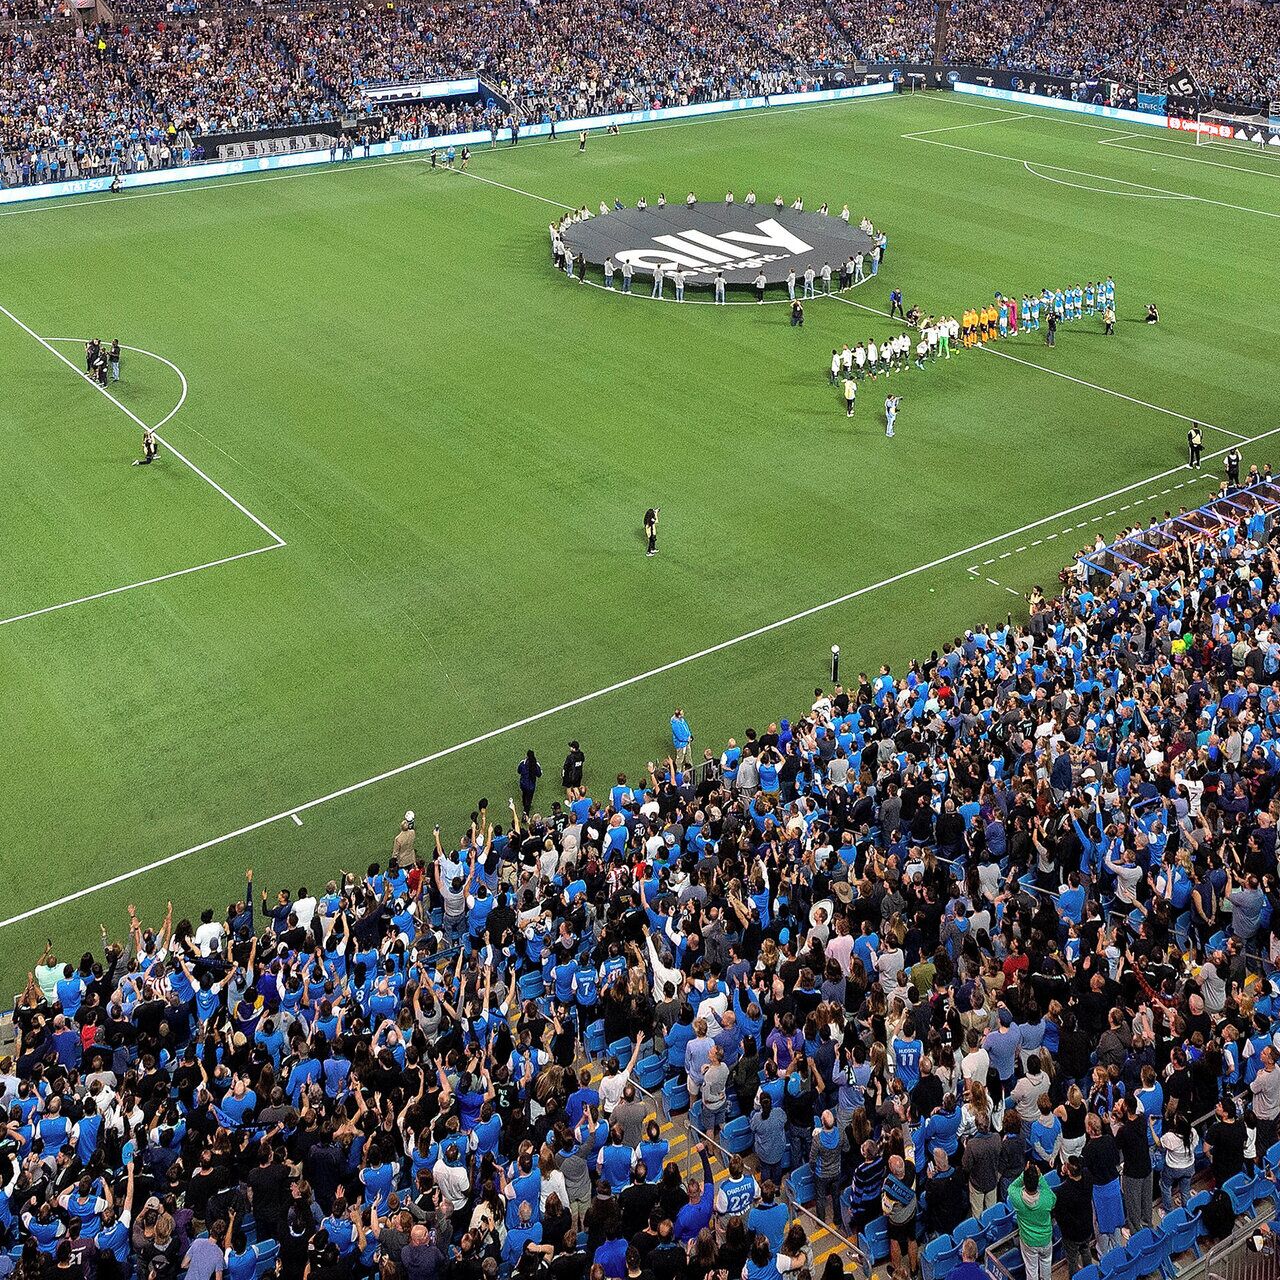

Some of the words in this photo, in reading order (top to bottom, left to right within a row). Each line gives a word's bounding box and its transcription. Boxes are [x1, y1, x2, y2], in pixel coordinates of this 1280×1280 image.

[614, 217, 815, 271] ally
[582, 982, 590, 996] 7
[901, 1053, 915, 1066] 11
[730, 1192, 751, 1211] 22
